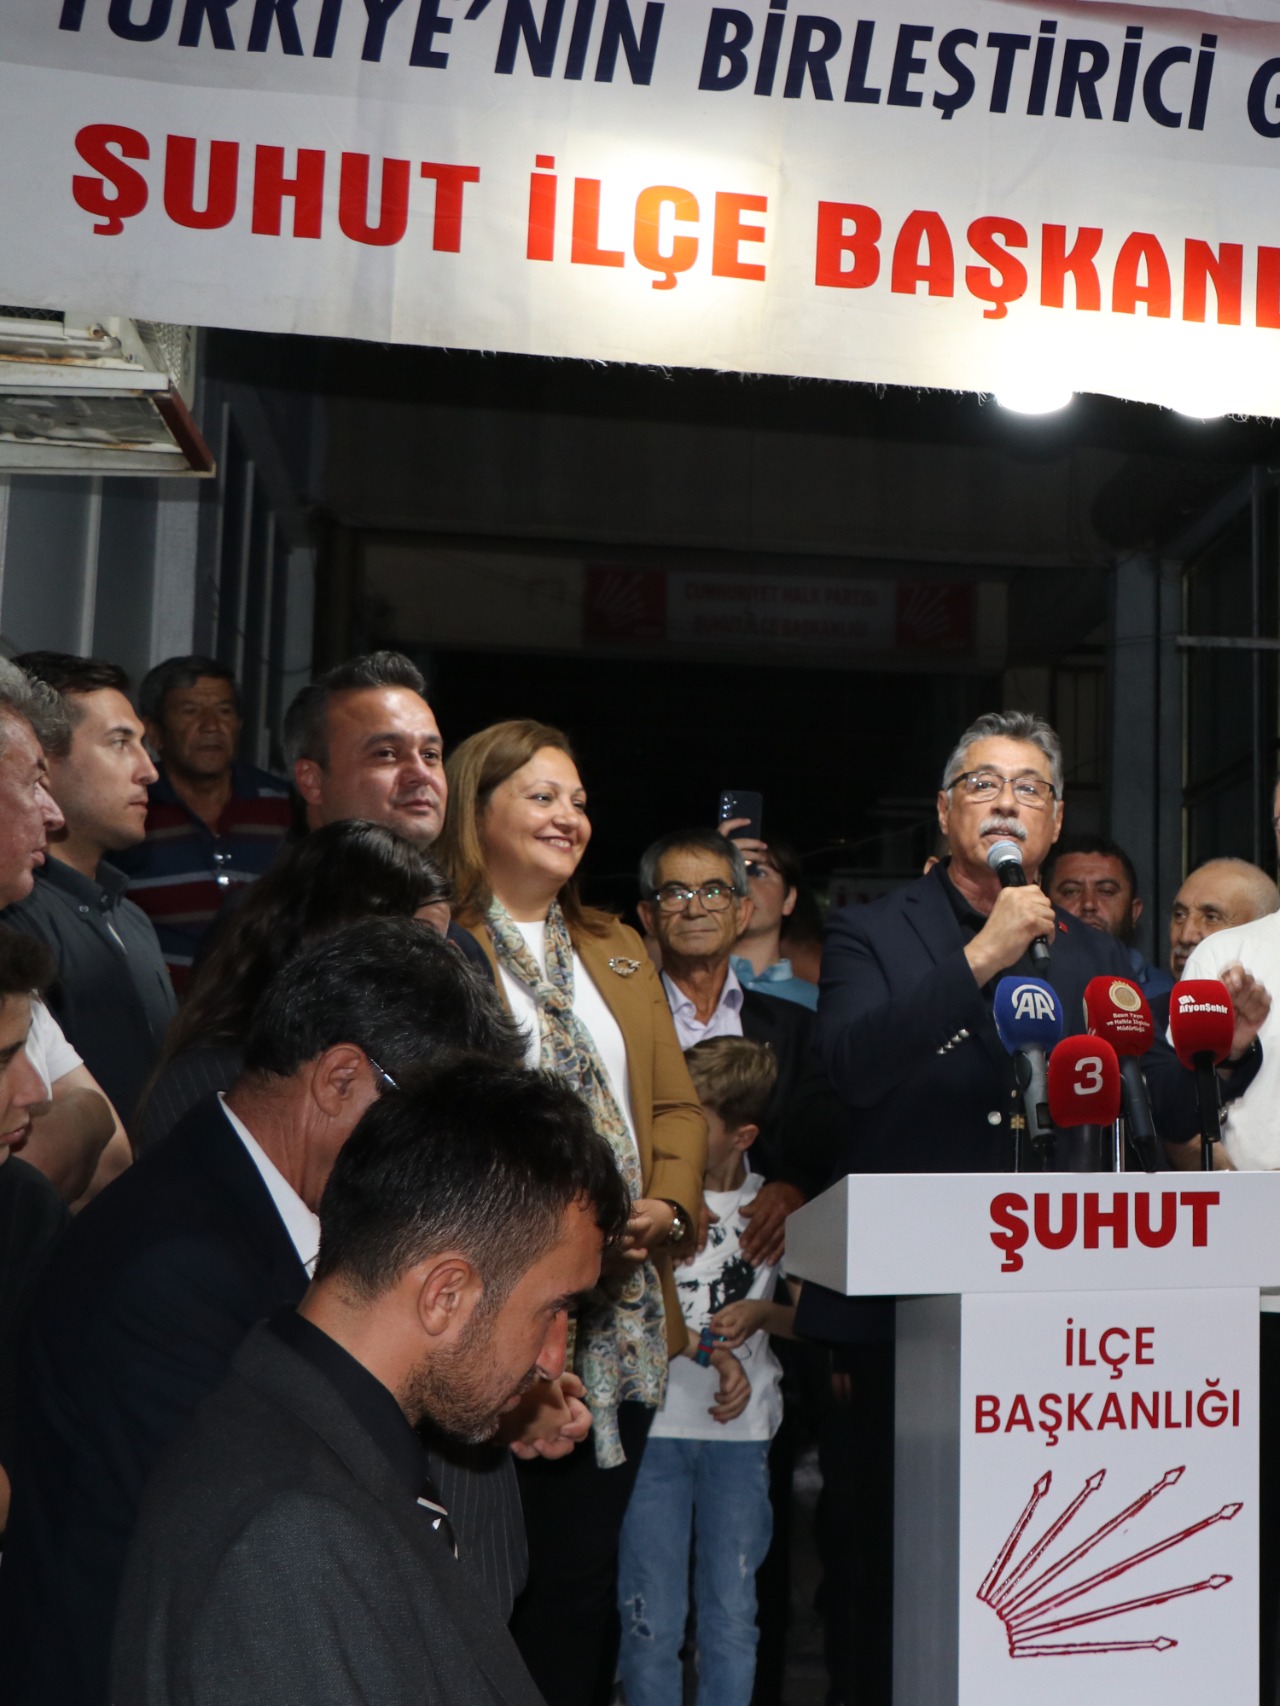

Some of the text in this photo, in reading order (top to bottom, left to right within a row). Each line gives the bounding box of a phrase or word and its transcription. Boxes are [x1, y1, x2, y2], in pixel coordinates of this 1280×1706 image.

[698, 0, 1217, 131] BİRLEŞTİRİCİ
[72, 123, 480, 254] ŞUHUT
[526, 154, 768, 290] İLÇE
[1014, 990, 1056, 1021] AA
[1073, 1056, 1103, 1096] 3
[989, 1191, 1220, 1273] ŞUHUT
[1065, 1317, 1155, 1379] İLÇE
[974, 1377, 1240, 1447] BAŞKANLIĞI
